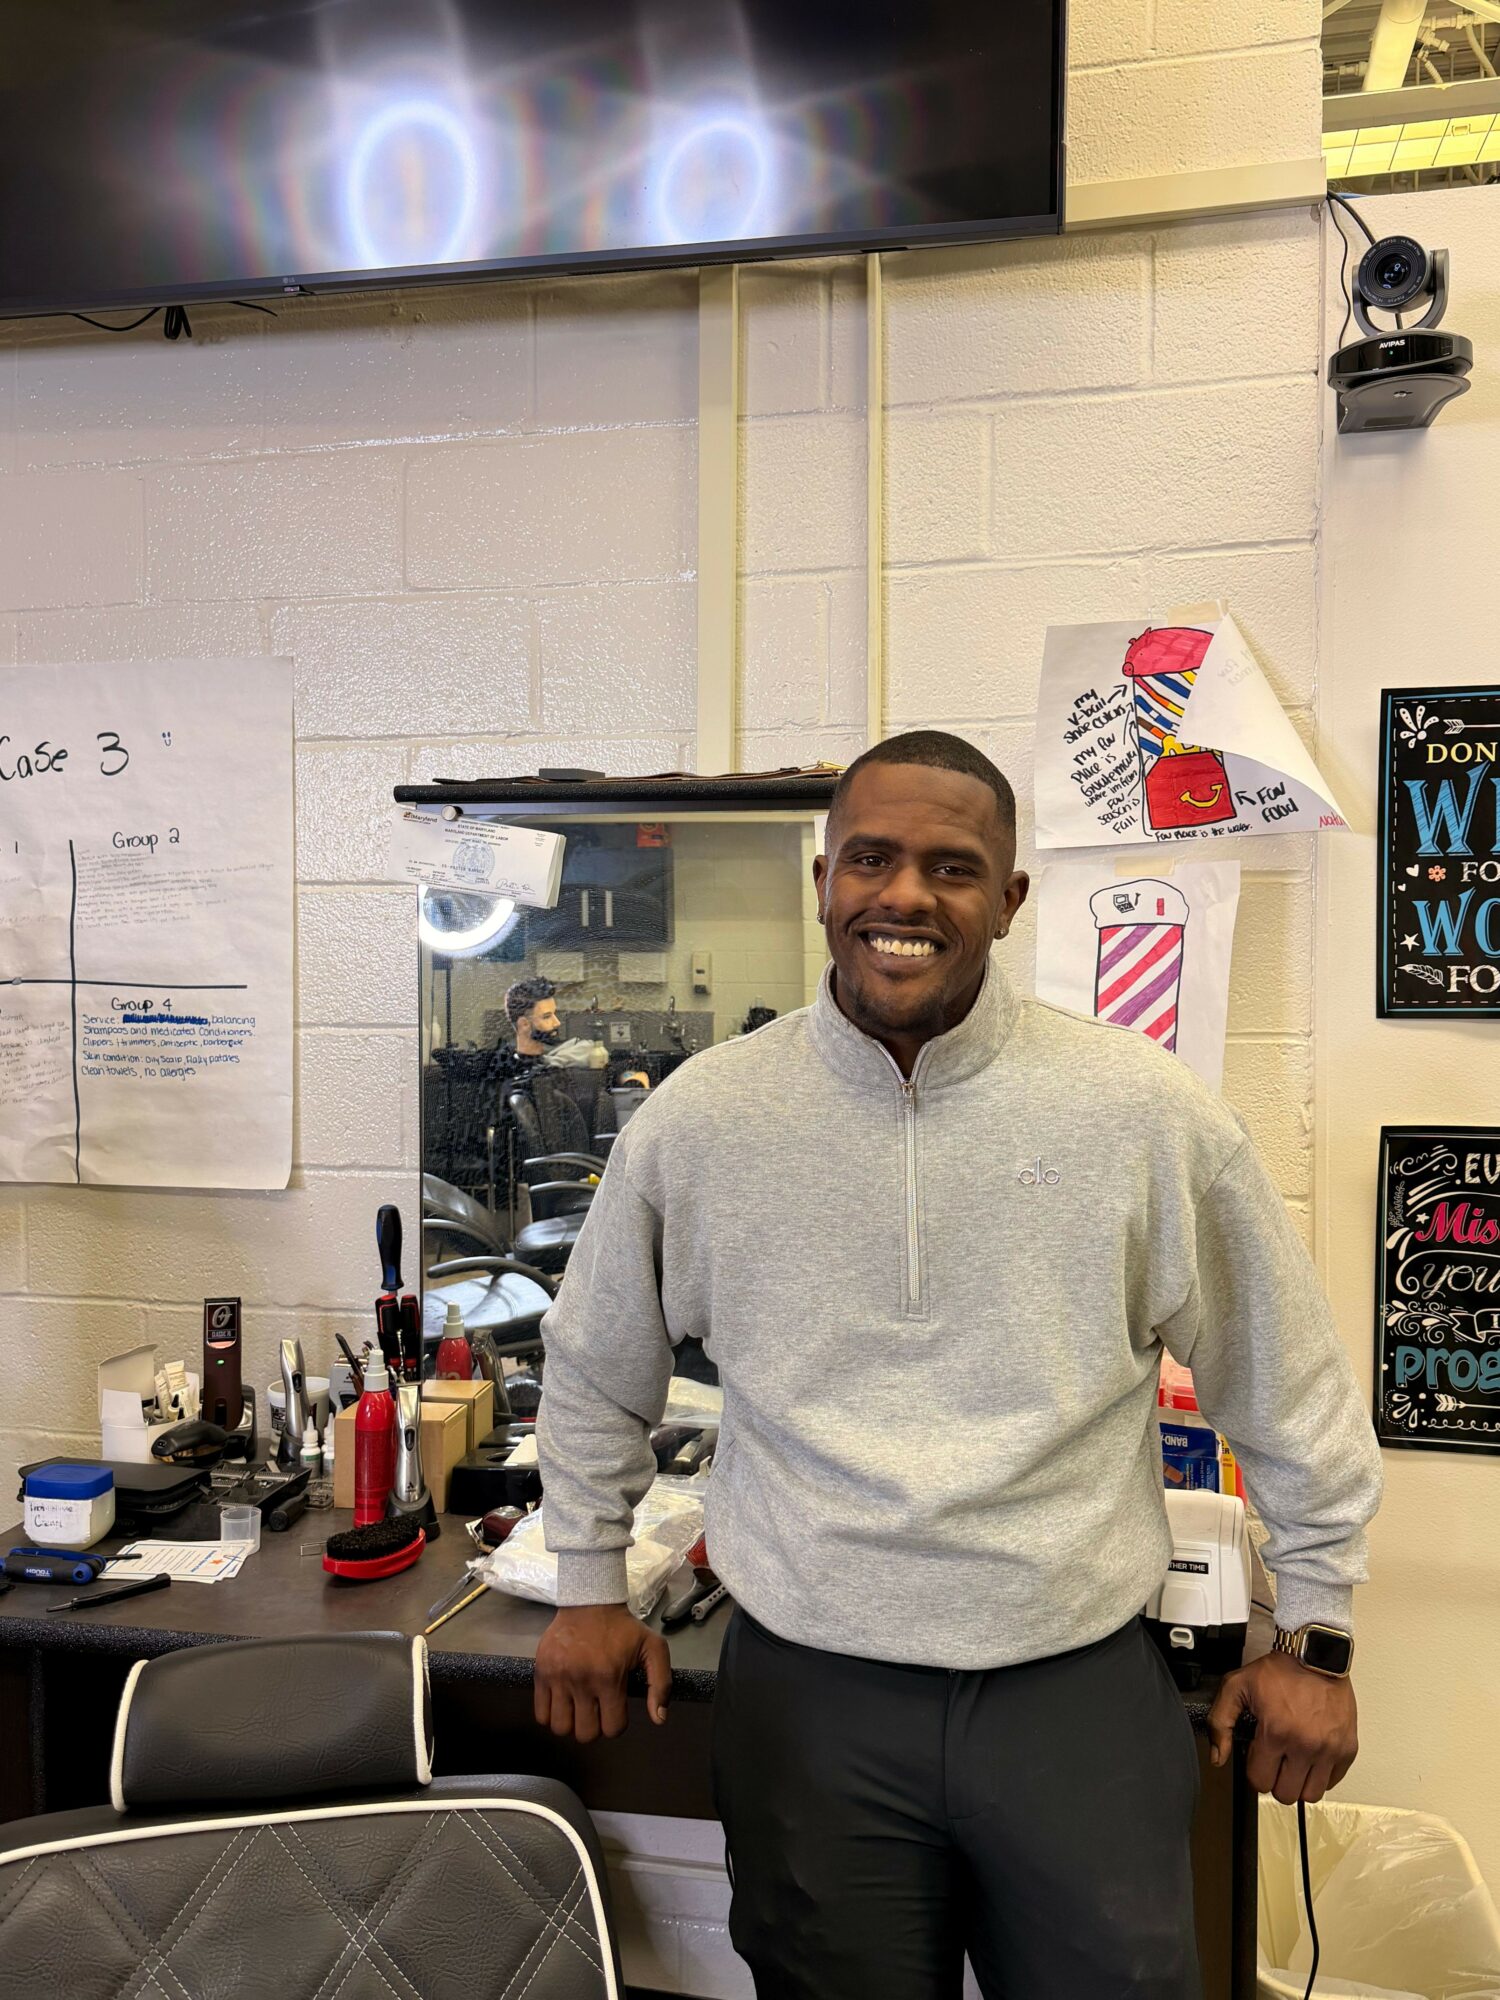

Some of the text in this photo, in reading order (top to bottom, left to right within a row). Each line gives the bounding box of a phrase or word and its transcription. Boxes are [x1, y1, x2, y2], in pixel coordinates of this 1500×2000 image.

[1379, 339, 1406, 350] AVIPAS
[1073, 688, 1098, 709] my
[0, 732, 130, 781] Case 3
[1073, 746, 1098, 766] my
[1101, 753, 1117, 764] is
[1128, 798, 1140, 807] is
[1199, 830, 1208, 838] is
[113, 828, 180, 854] Group 2
[112, 997, 173, 1013] Group 4
[130, 1026, 148, 1036] and
[150, 1027, 196, 1036] medicated
[144, 1066, 156, 1076] no
[1189, 1564, 1206, 1572] TIME
